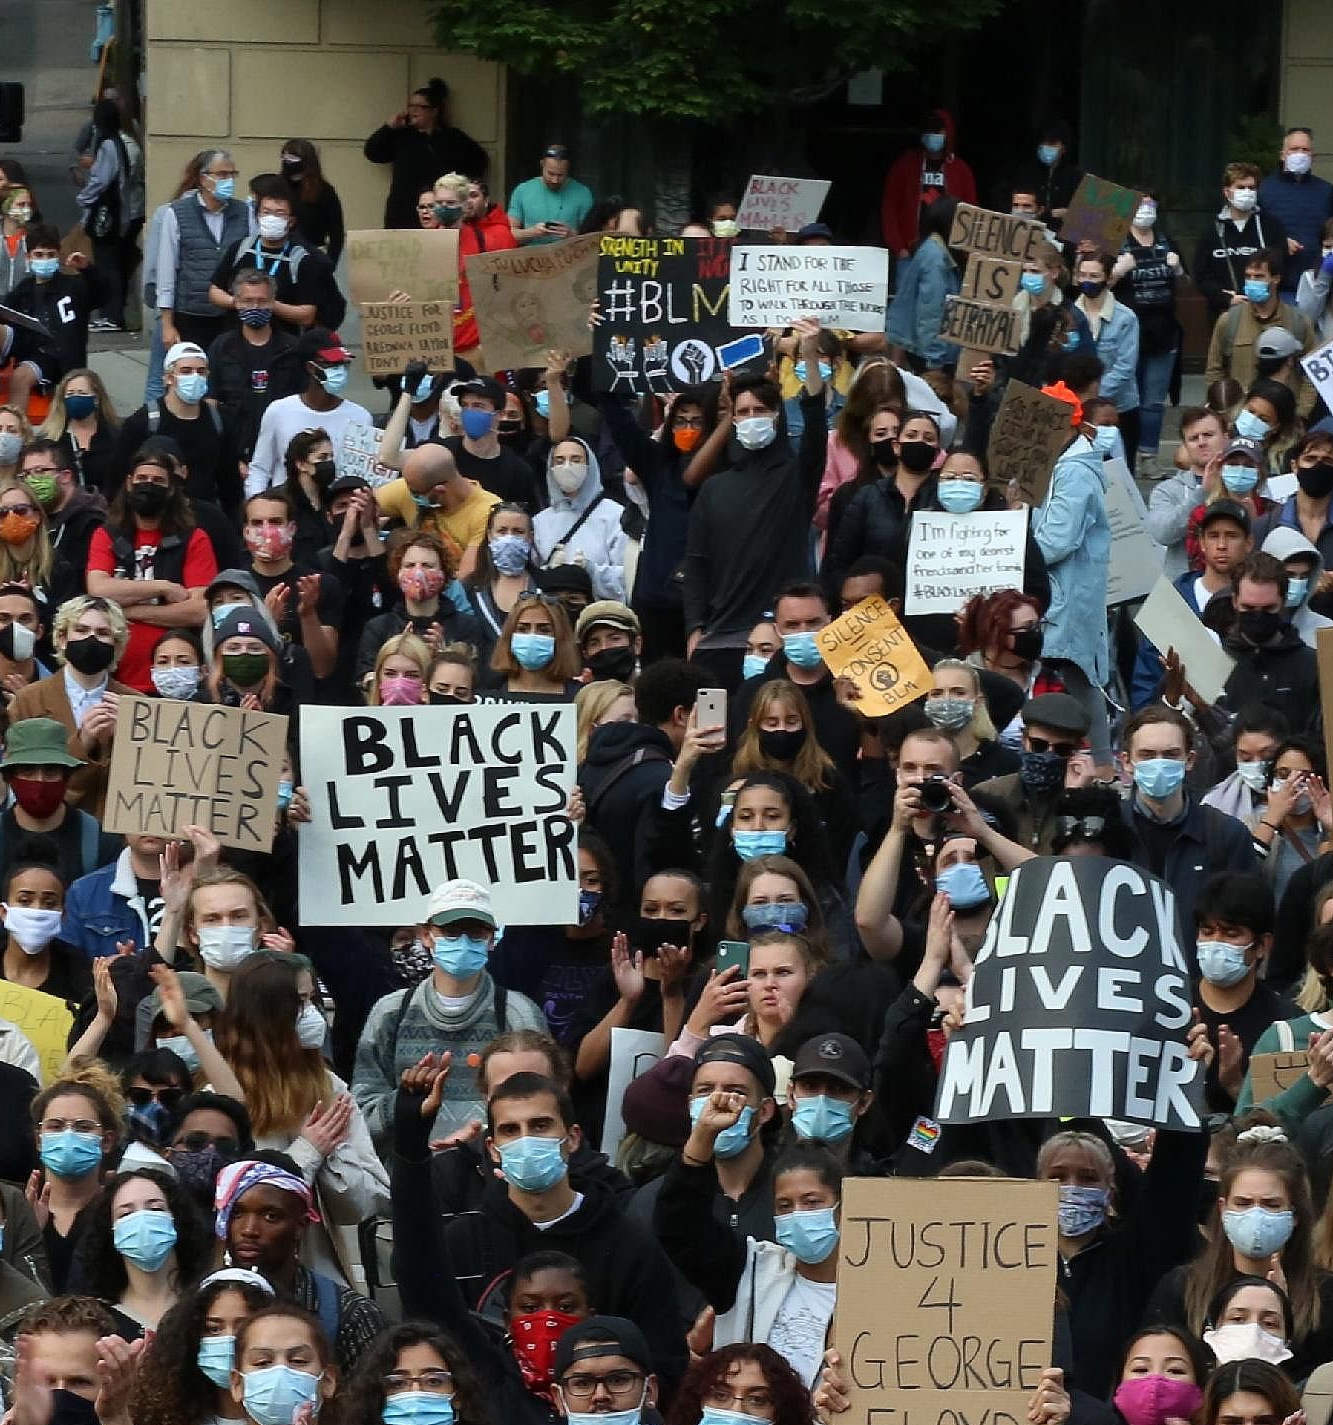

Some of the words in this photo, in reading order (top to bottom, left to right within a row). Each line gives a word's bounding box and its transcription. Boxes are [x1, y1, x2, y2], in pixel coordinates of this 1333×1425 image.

[599, 238, 658, 257] STRENGTH
[662, 237, 686, 256] IN
[951, 209, 1044, 262] SILENCE
[614, 259, 660, 279] UNITY
[736, 252, 747, 277] I
[755, 254, 801, 276] STAND
[804, 254, 829, 275] FOR
[832, 254, 856, 276] THE
[739, 279, 781, 298] RIGHT
[785, 279, 808, 297] FOR
[810, 278, 833, 296] ALL
[835, 279, 873, 297] THOSE
[970, 267, 1010, 300] IS
[367, 303, 413, 319] JUSTICE
[421, 303, 442, 316] FOR
[368, 321, 406, 336] GEORGE
[943, 301, 1020, 350] BETRAYAL
[821, 600, 890, 653] SILENCE
[842, 628, 907, 679] CONSENT
[880, 678, 919, 706] BLM
[131, 700, 270, 757] BLACK
[344, 711, 568, 777] BLACK
[132, 746, 268, 800] LIVES
[326, 763, 568, 830] LIVES
[112, 788, 263, 842] MATTER
[337, 815, 577, 906] MATTER
[961, 964, 1193, 1030] LIVES
[937, 1027, 1201, 1128] MATTER
[846, 1216, 1048, 1270] JUSTICE
[918, 1277, 962, 1334] 4
[850, 1331, 1047, 1393] GEORGE
